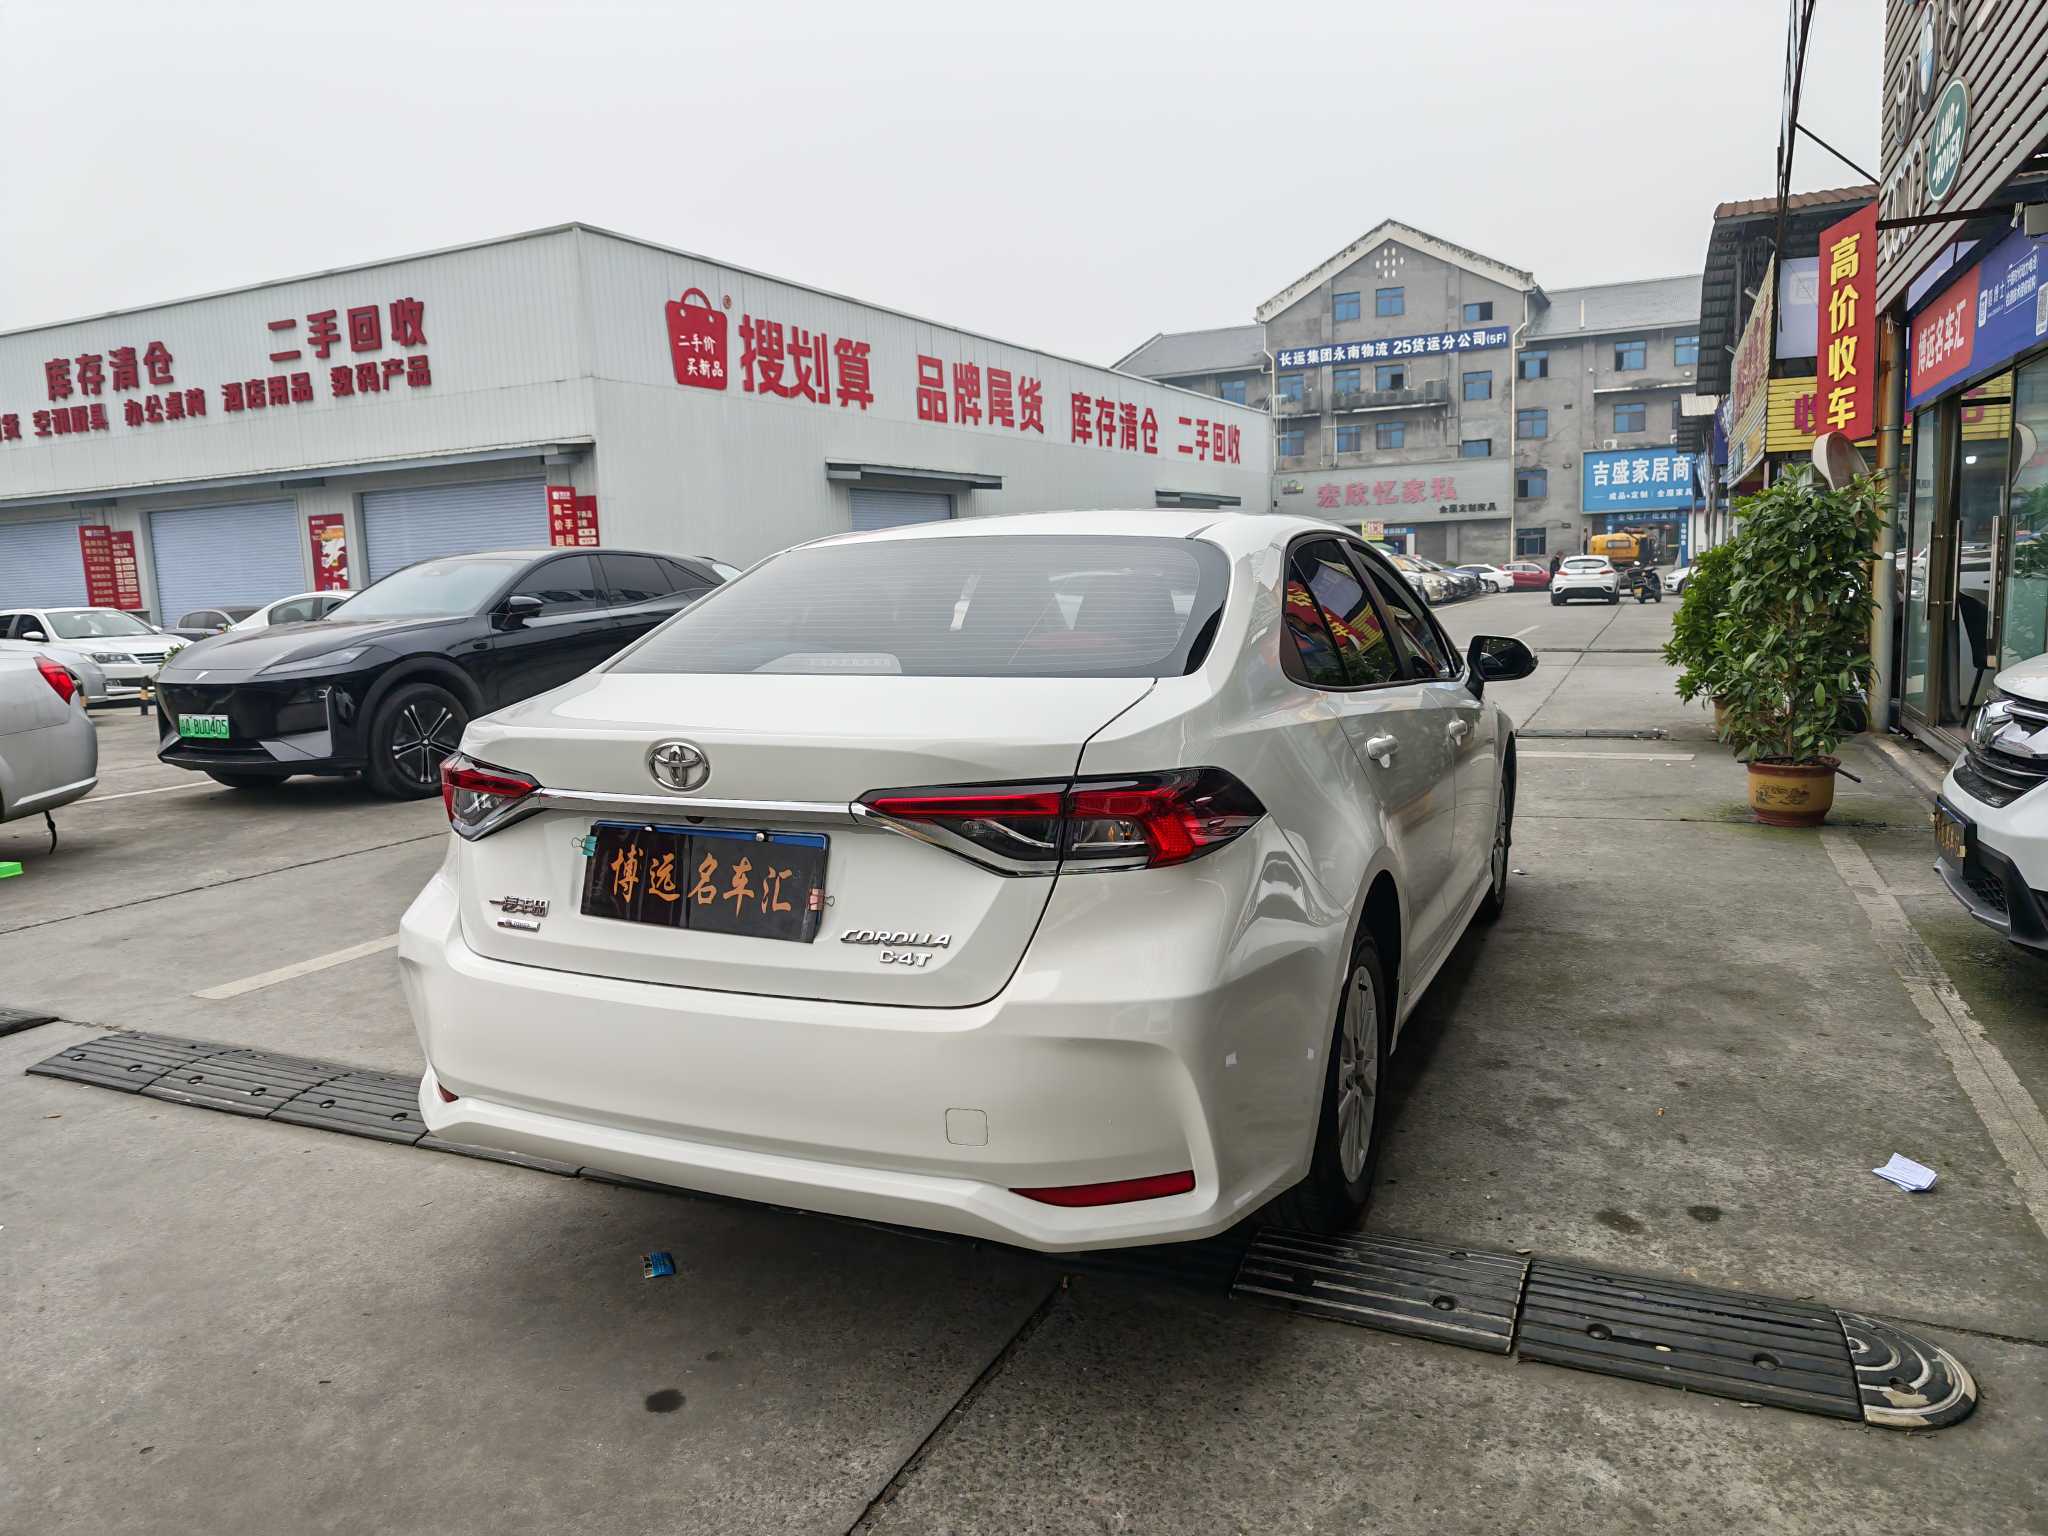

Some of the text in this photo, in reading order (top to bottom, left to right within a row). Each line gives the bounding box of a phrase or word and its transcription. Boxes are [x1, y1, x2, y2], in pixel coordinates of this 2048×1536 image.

[44, 297, 428, 401] 库存清仓 二手回收
[678, 333, 717, 354] 二手价
[687, 358, 723, 378] 买新品
[739, 314, 874, 410] 搜划算
[1279, 343, 1388, 367] 长运集团永南物流
[1827, 232, 1861, 430] 高价收车
[1917, 299, 1967, 376] 博远名车汇
[0, 413, 22, 442] 货
[124, 388, 206, 427] 办公桌椅
[221, 372, 314, 412] 酒店用品
[330, 355, 431, 397] 数码产品
[917, 354, 1241, 465] 品牌尾货 库存清仓 二手回收
[610, 843, 792, 919] 博远名车汇
[841, 929, 951, 948] COROLLA
